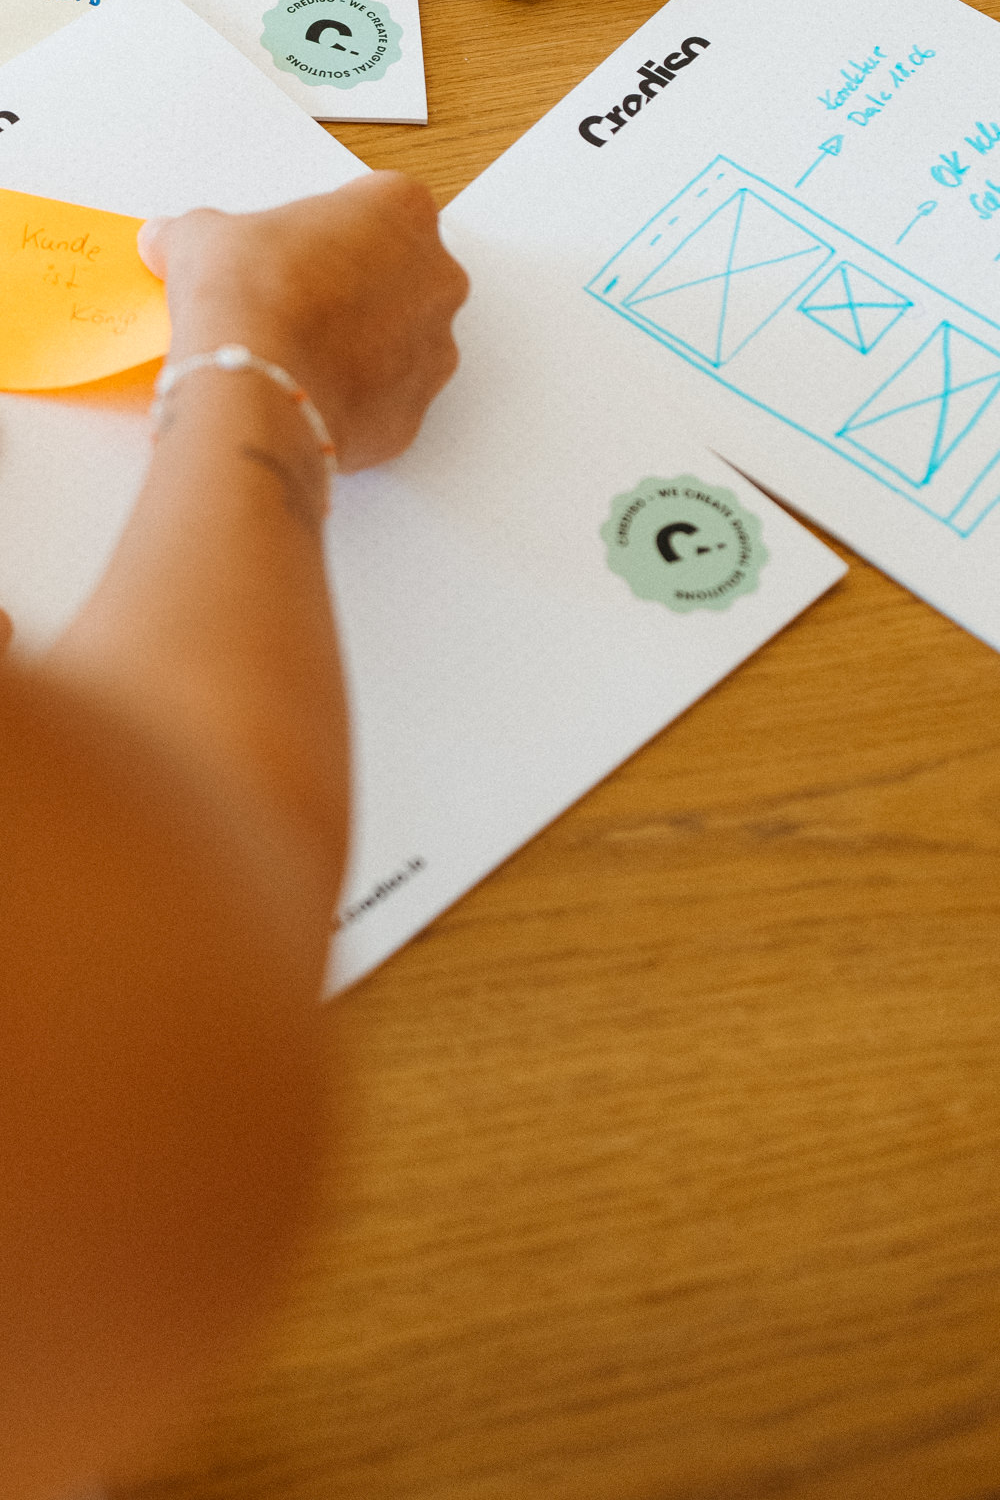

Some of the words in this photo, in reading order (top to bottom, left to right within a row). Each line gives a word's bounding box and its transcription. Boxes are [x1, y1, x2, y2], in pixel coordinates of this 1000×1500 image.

[349, 0, 367, 12] WE
[366, 11, 388, 44] CREATE
[285, 54, 351, 79] SOLUTIONS
[352, 45, 387, 75] DIGITAL
[21, 223, 102, 262] Kunde
[43, 263, 79, 289] ist
